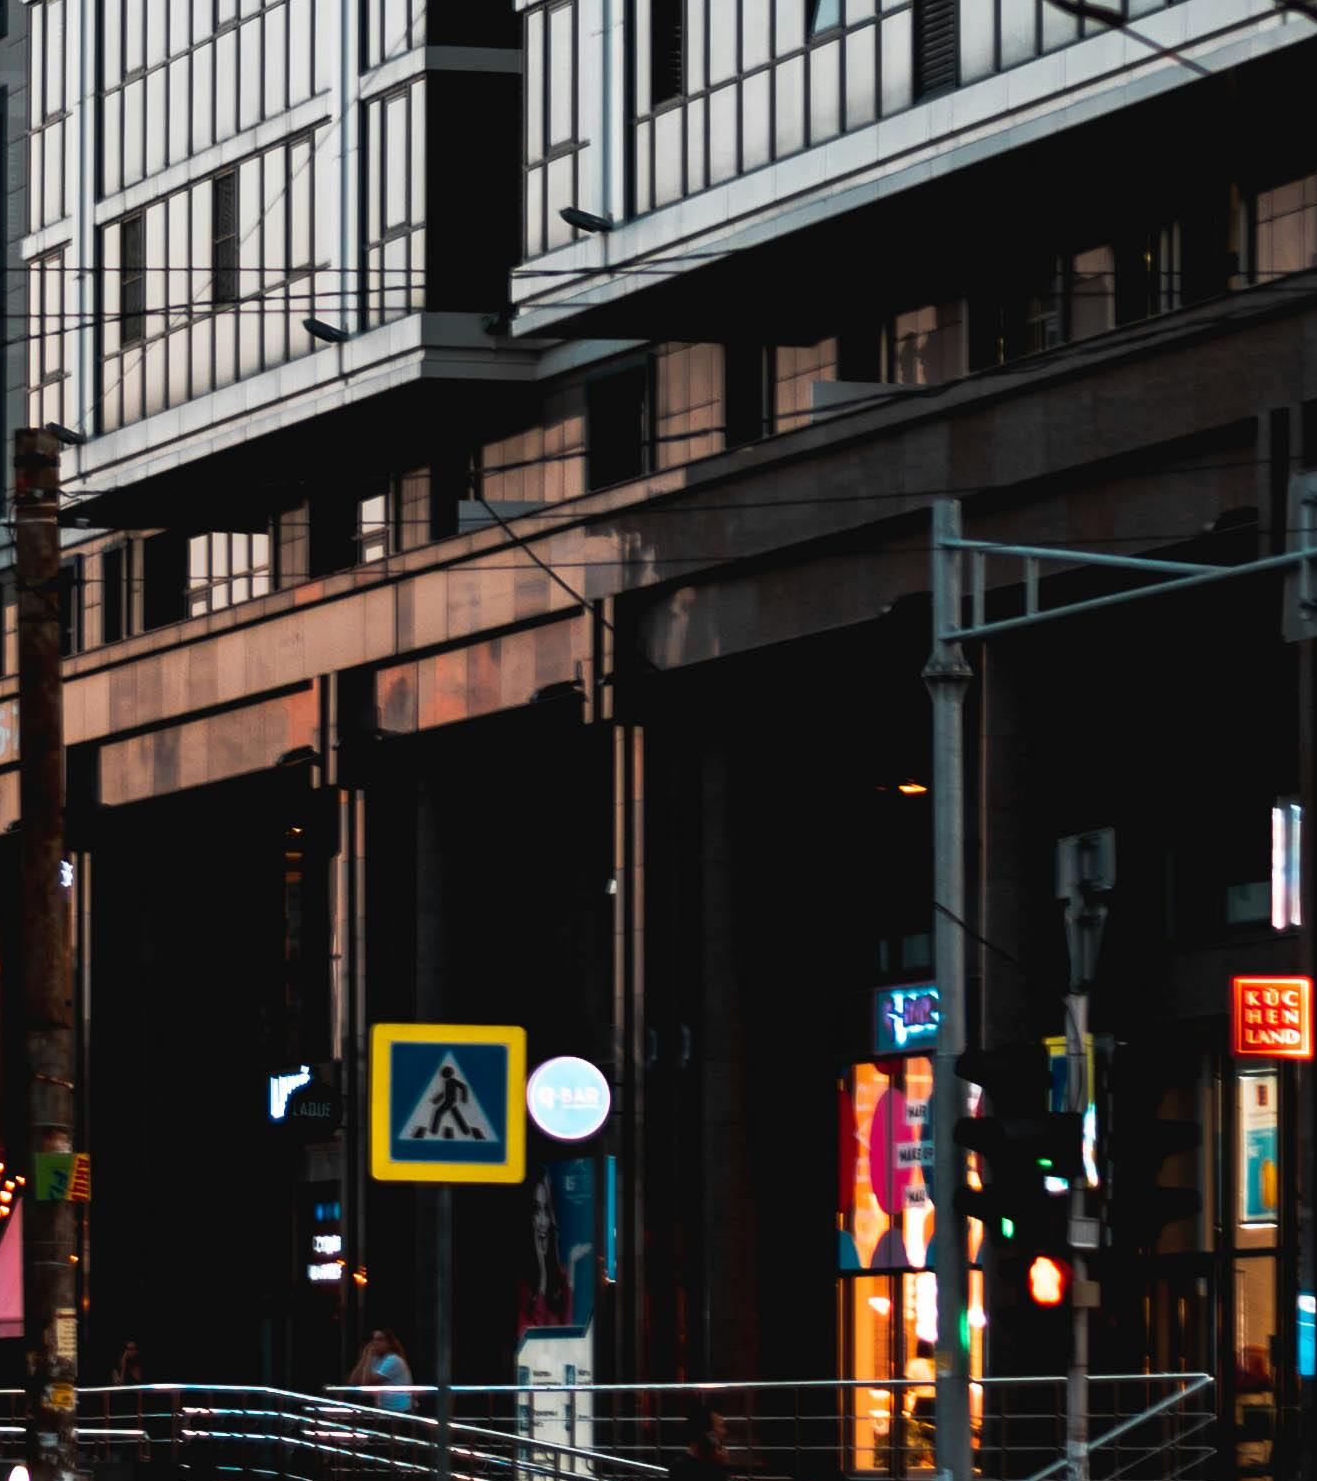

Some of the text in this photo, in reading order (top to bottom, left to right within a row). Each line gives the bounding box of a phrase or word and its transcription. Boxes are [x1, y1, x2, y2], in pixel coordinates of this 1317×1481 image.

[1243, 987, 1300, 1007] KÜC
[1244, 1007, 1300, 1024] HEN
[1244, 1027, 1301, 1045] LAND
